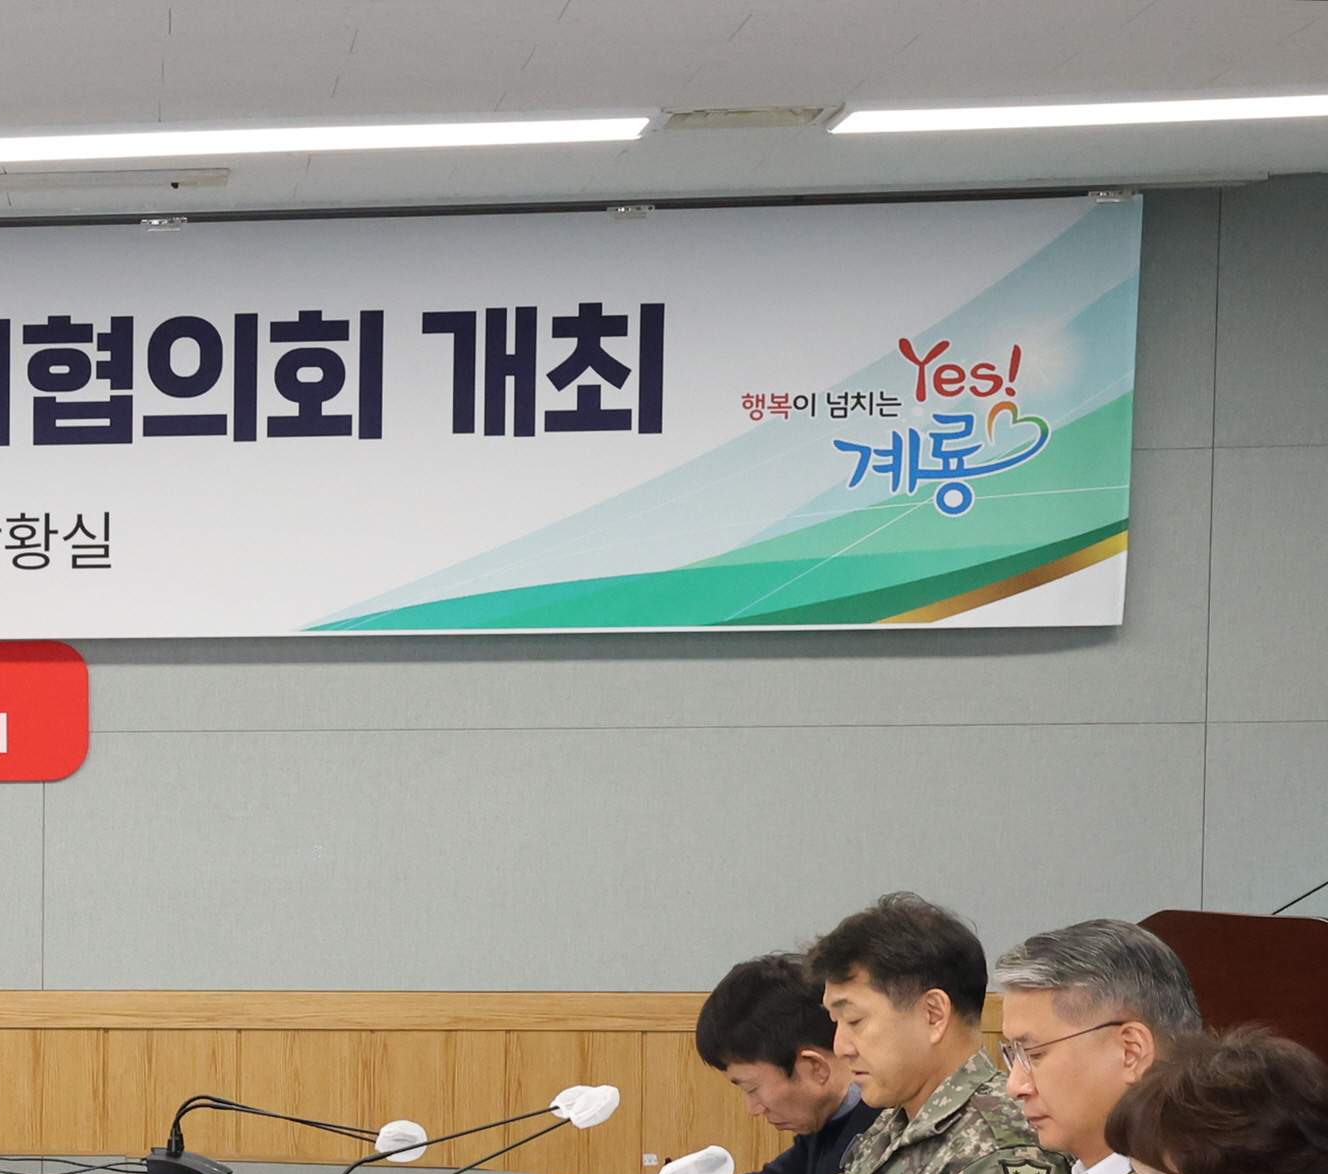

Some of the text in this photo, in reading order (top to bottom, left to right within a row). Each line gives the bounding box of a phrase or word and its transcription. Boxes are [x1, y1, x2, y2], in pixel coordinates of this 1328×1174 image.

[421, 302, 666, 437] 개최
[741, 391, 902, 421] 행복이 넘치는
[898, 338, 1022, 402] Yes!
[833, 413, 1009, 516] 계룡
